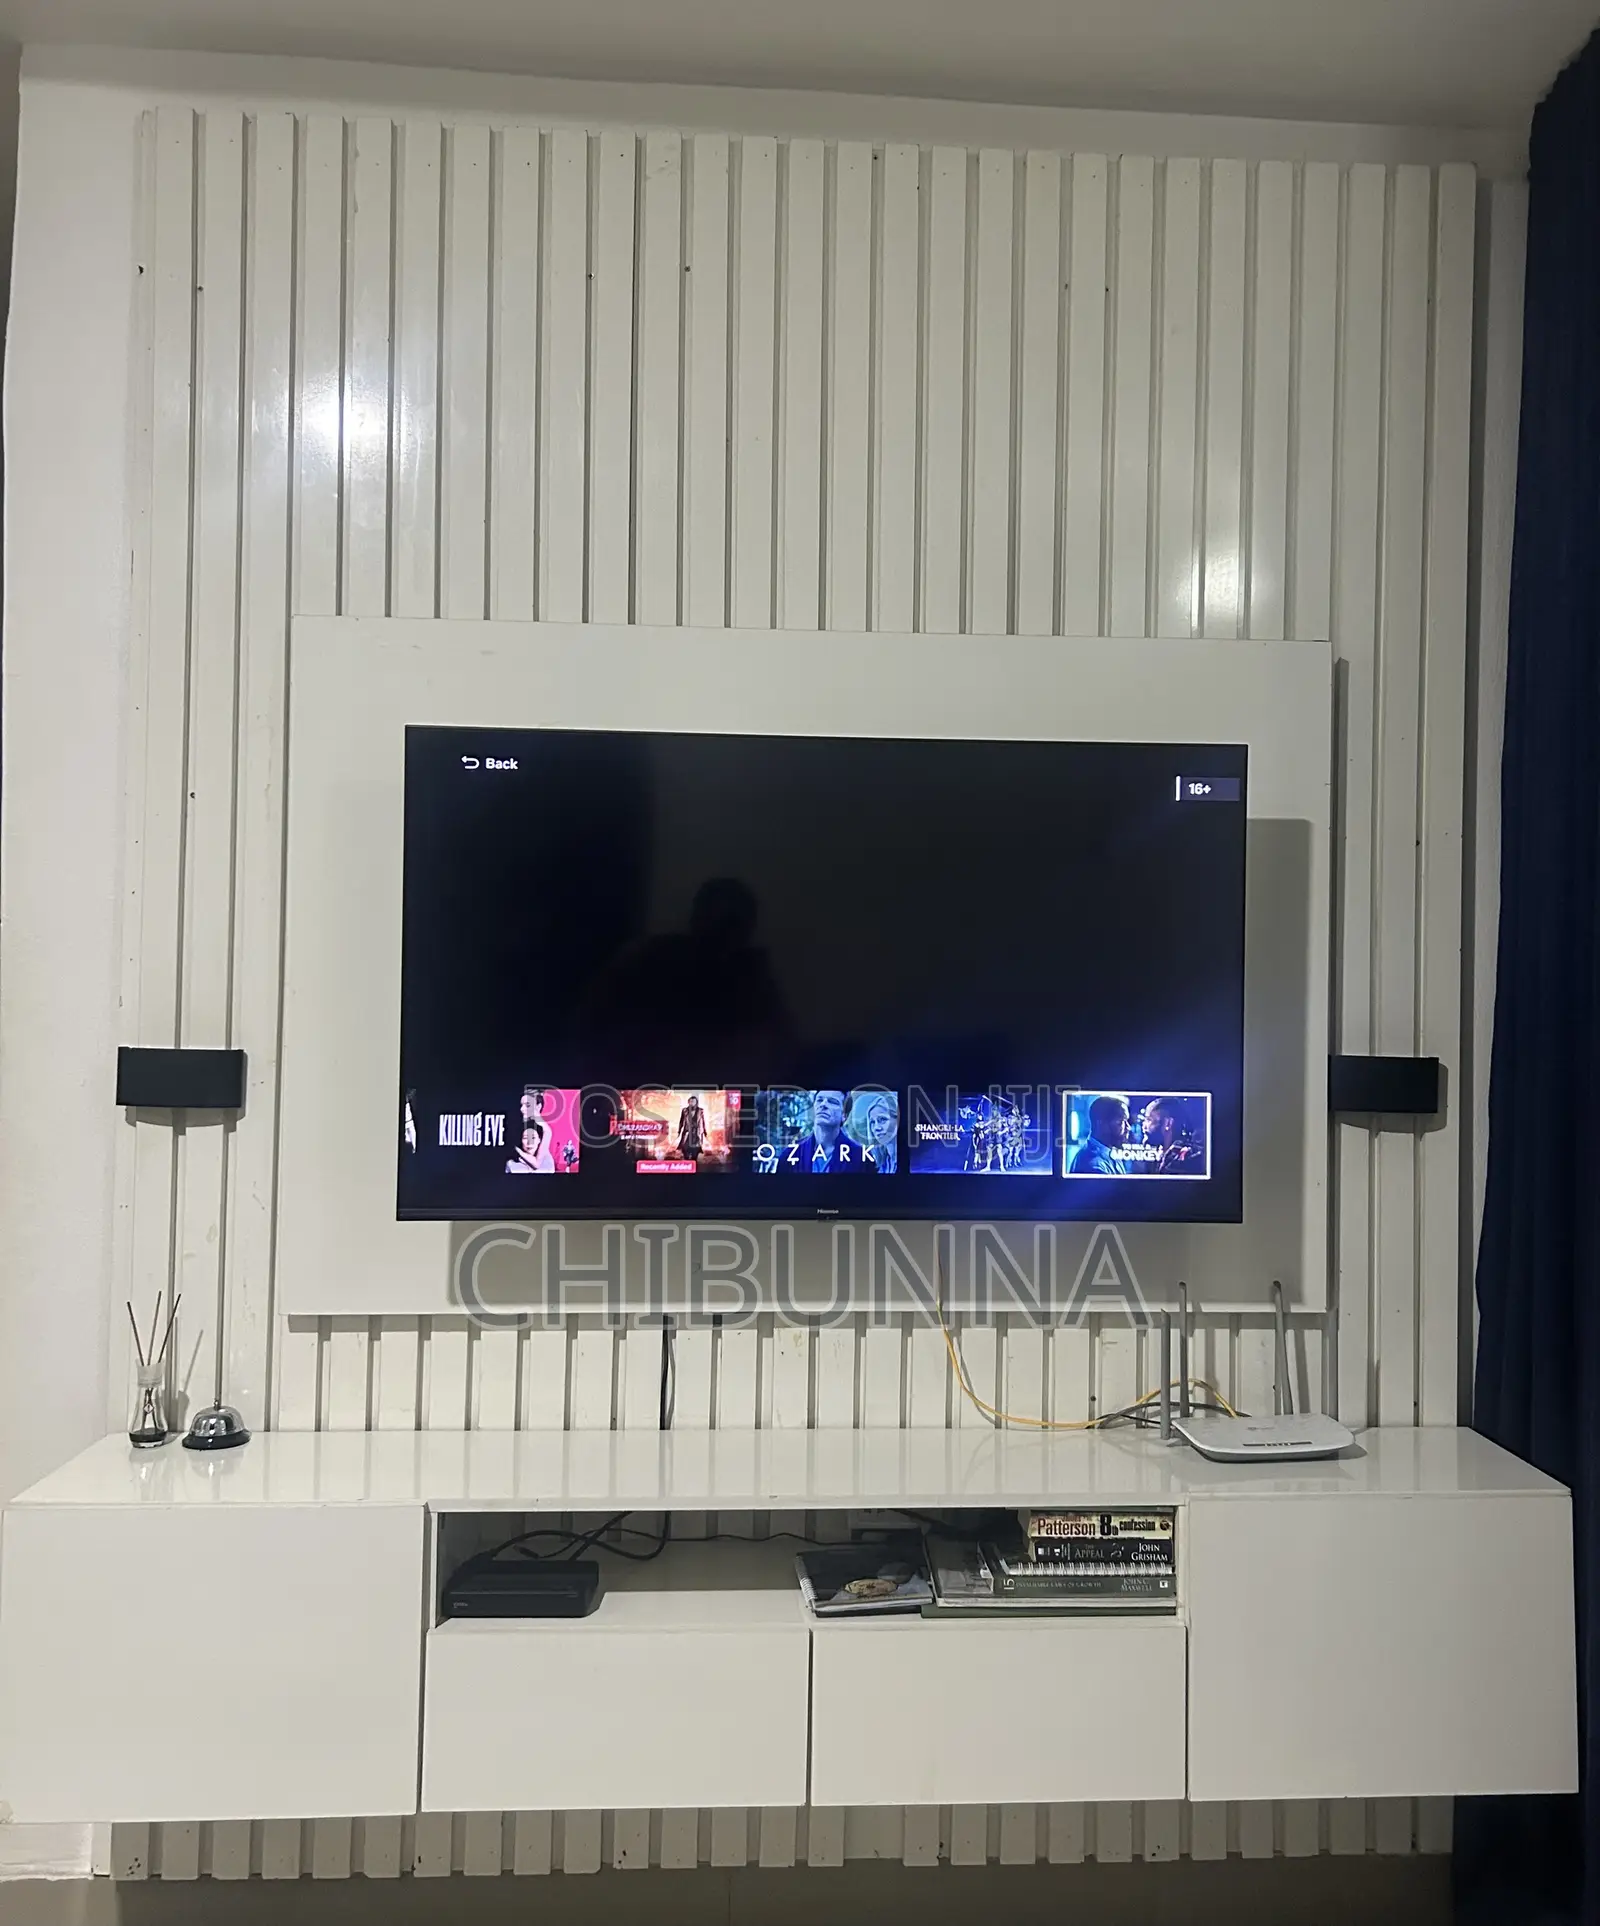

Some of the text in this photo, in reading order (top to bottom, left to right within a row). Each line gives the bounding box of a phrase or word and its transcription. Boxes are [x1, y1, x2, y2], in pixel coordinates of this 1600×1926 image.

[485, 757, 519, 770] Back
[1188, 782, 1212, 795] 16+
[439, 1112, 505, 1147] KILLING EVE
[920, 1132, 961, 1140] FRONTIER
[756, 1143, 875, 1165] OZARK
[1110, 1147, 1163, 1161] MONKEY
[640, 1162, 693, 1171] Recently Added
[1037, 1518, 1096, 1536] Patterson
[1119, 1519, 1156, 1531] confession
[1139, 1543, 1160, 1553] JOHN
[1131, 1552, 1168, 1561] GRISHAM
